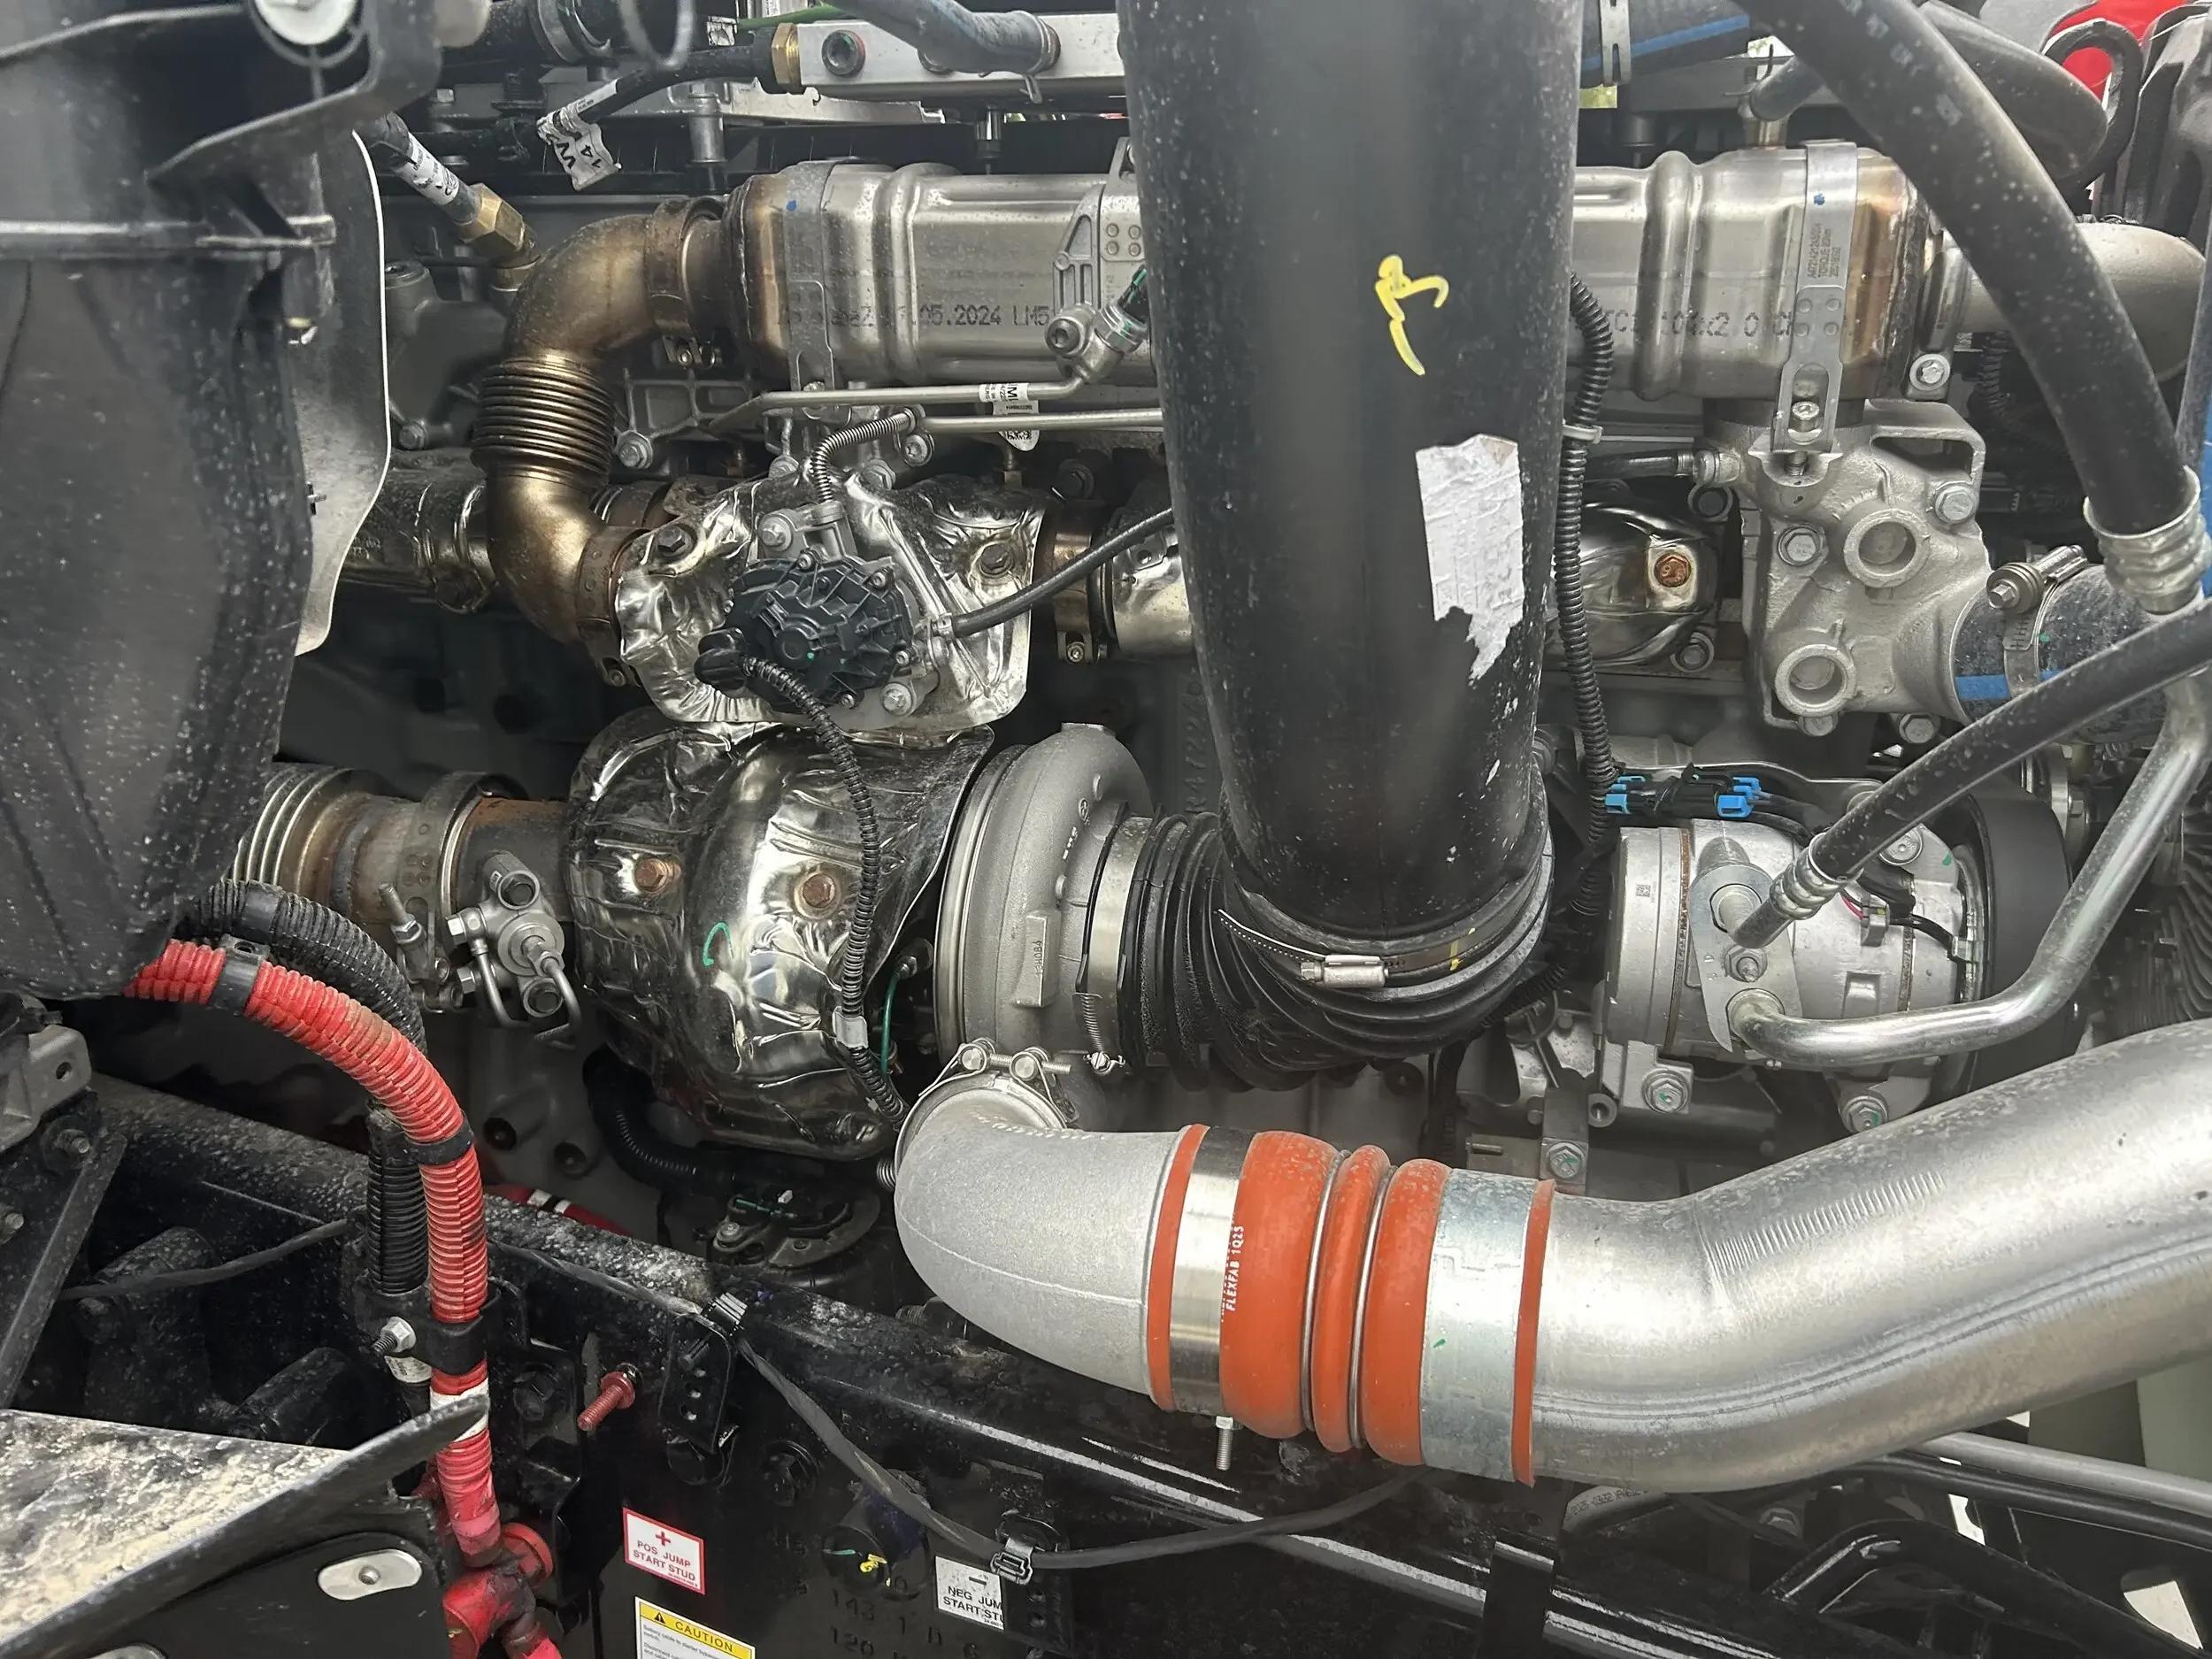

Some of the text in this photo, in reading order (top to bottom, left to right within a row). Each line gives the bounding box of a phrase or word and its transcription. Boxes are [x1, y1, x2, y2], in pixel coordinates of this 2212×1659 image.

[1225, 1260, 1240, 1311] FLEXFAB
[633, 1549, 665, 1569] START
[668, 1565, 695, 1581] STUD
[636, 1540, 691, 1568] POS JUMP
[943, 1596, 980, 1615] START
[949, 1586, 972, 1601] NEG
[675, 1620, 733, 1653] CAUTION
